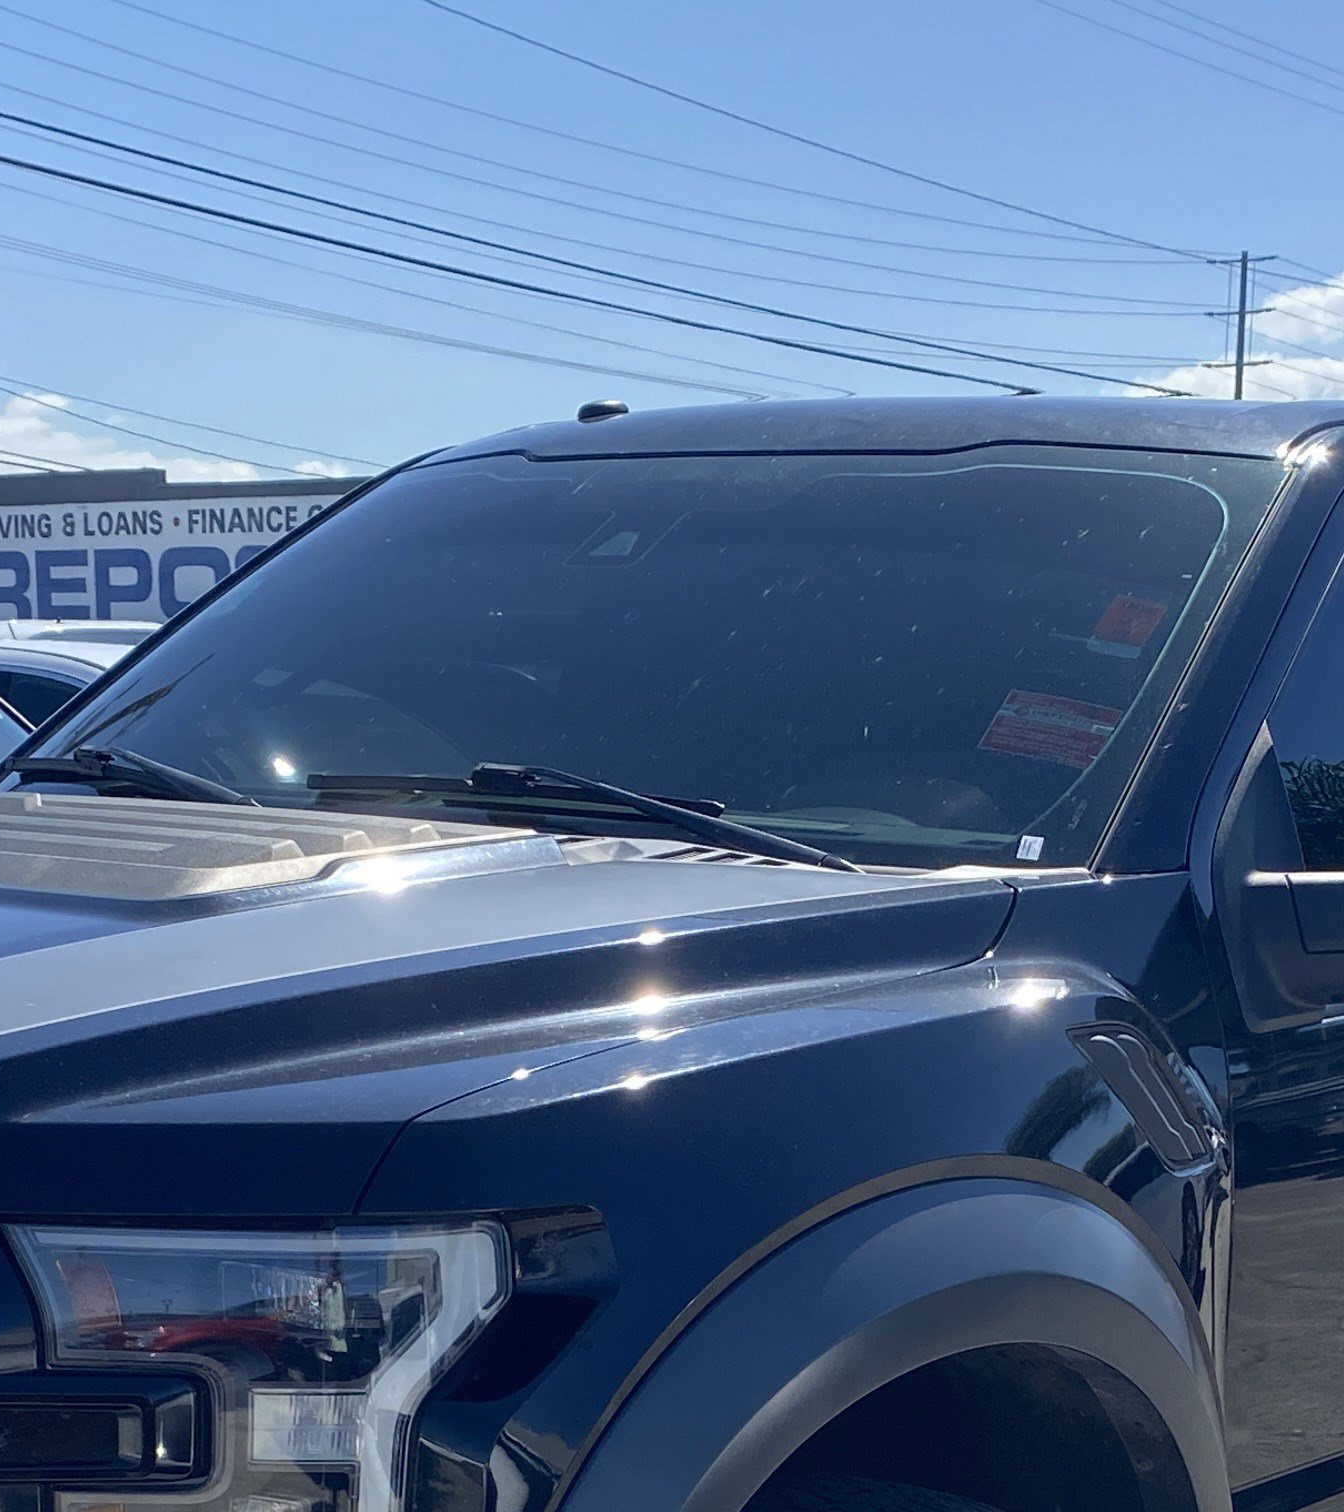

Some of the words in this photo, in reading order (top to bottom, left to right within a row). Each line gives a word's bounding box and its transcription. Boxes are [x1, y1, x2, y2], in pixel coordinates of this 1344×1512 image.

[62, 512, 75, 537] &
[83, 510, 163, 537] LOANS
[188, 505, 298, 534] FINANCE
